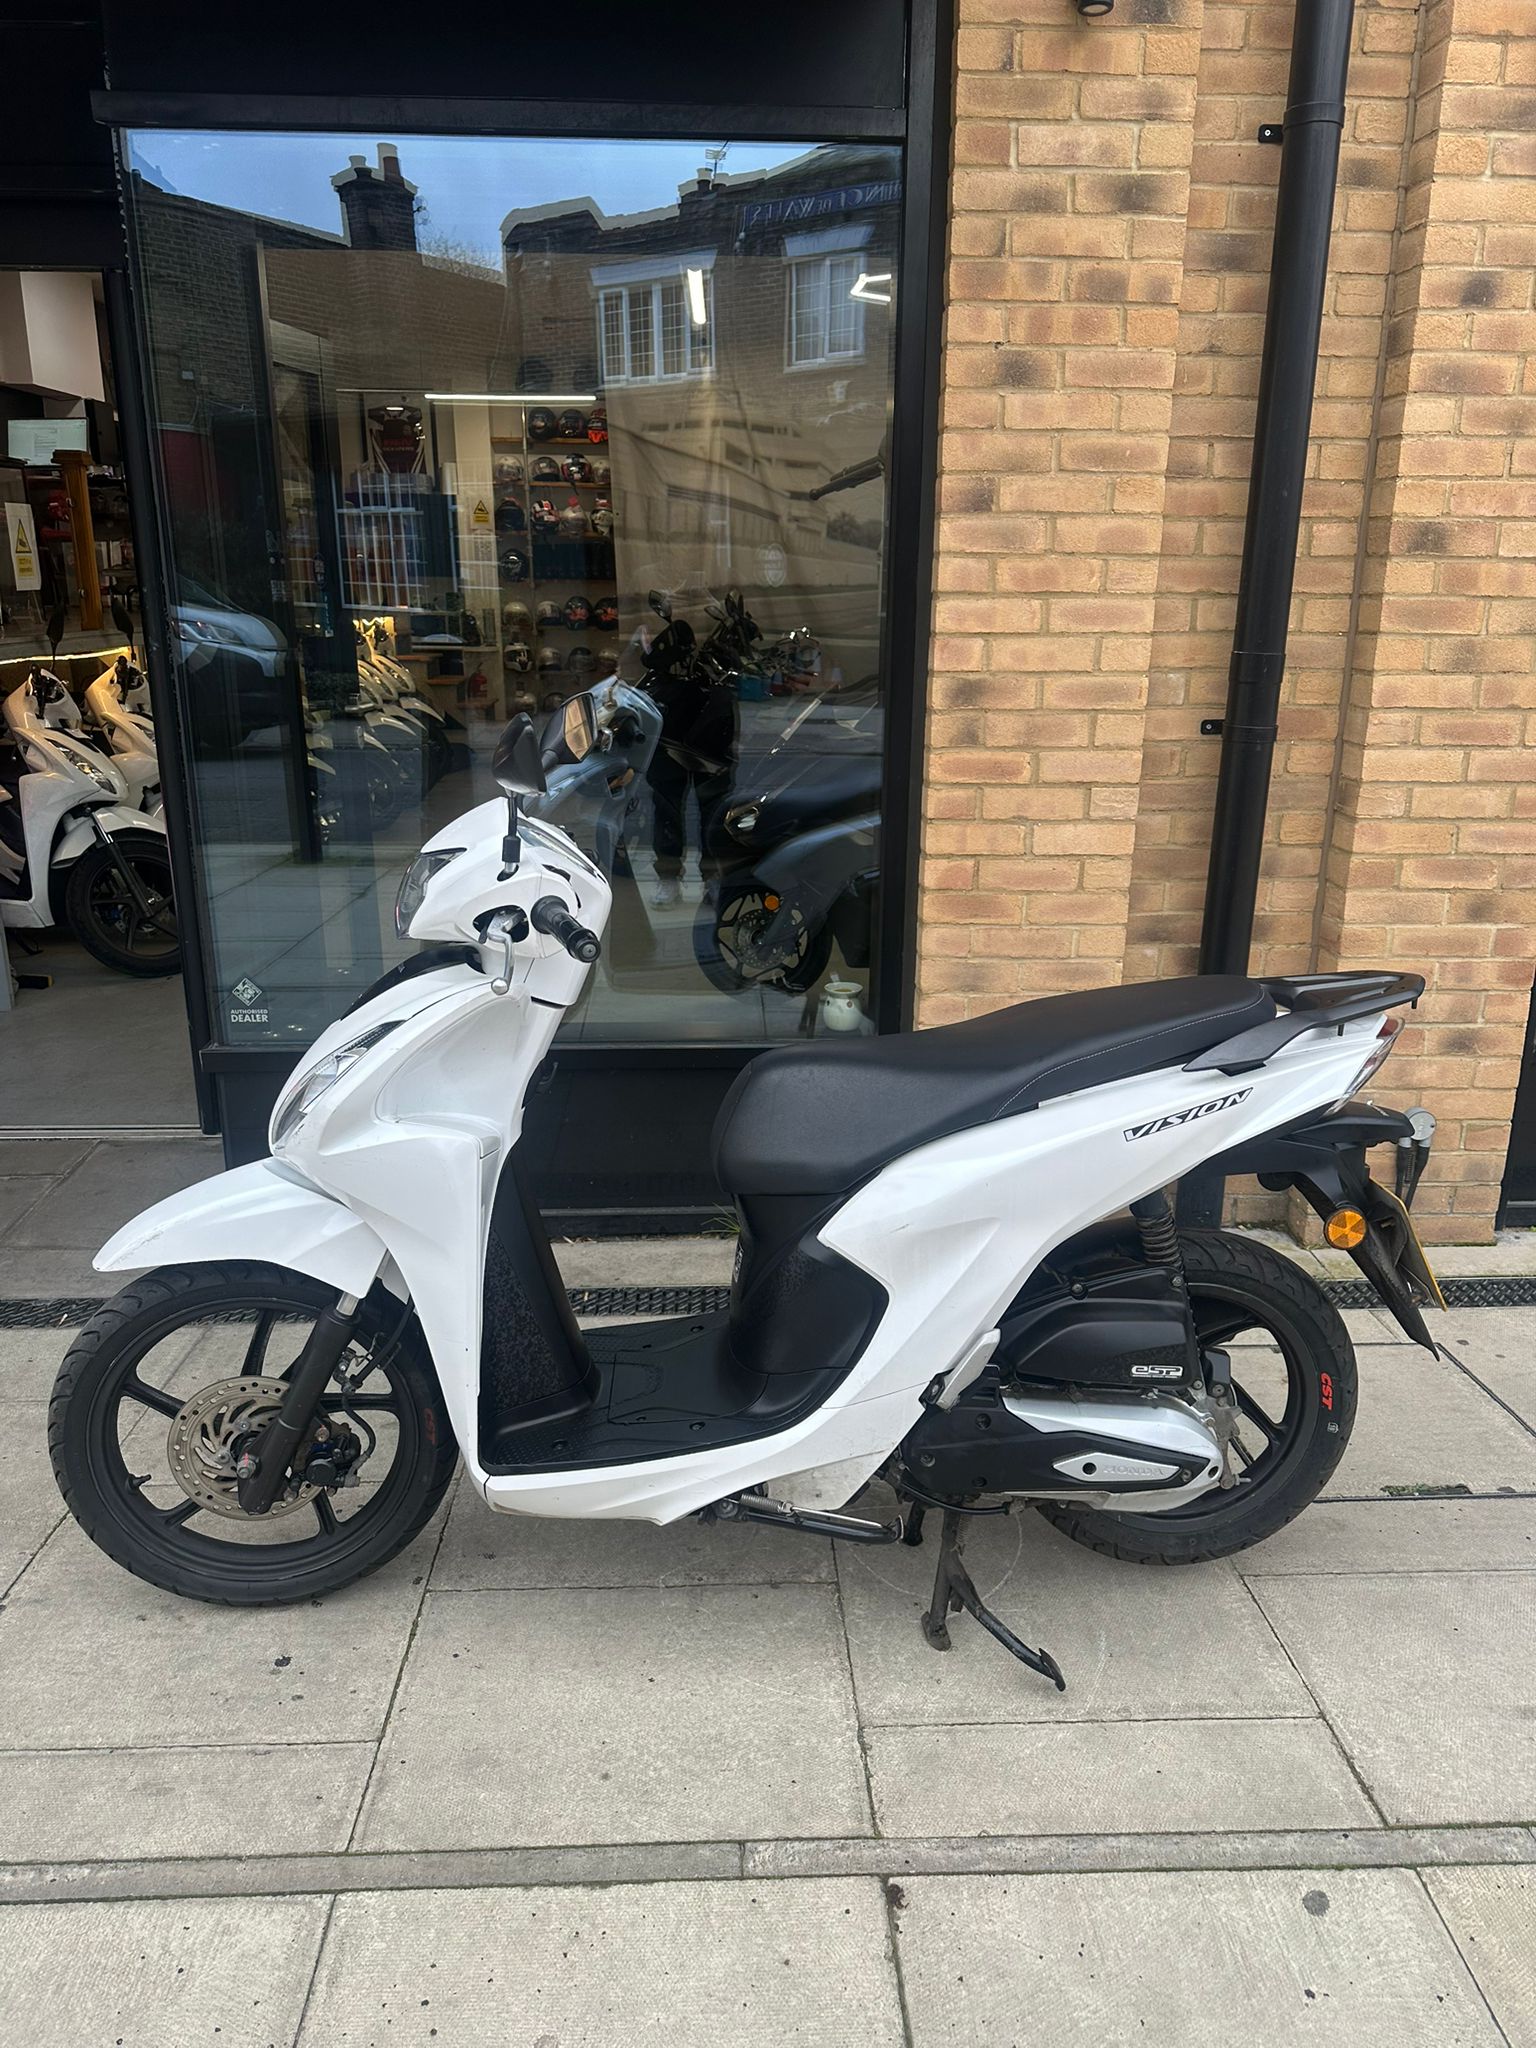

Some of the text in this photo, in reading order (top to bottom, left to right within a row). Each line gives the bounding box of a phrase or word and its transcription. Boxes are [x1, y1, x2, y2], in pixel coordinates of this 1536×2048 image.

[231, 1014, 269, 1023] DEALER
[1123, 1087, 1253, 1142] VISION
[1321, 1372, 1333, 1411] CST
[1103, 1465, 1164, 1477] HONDA
